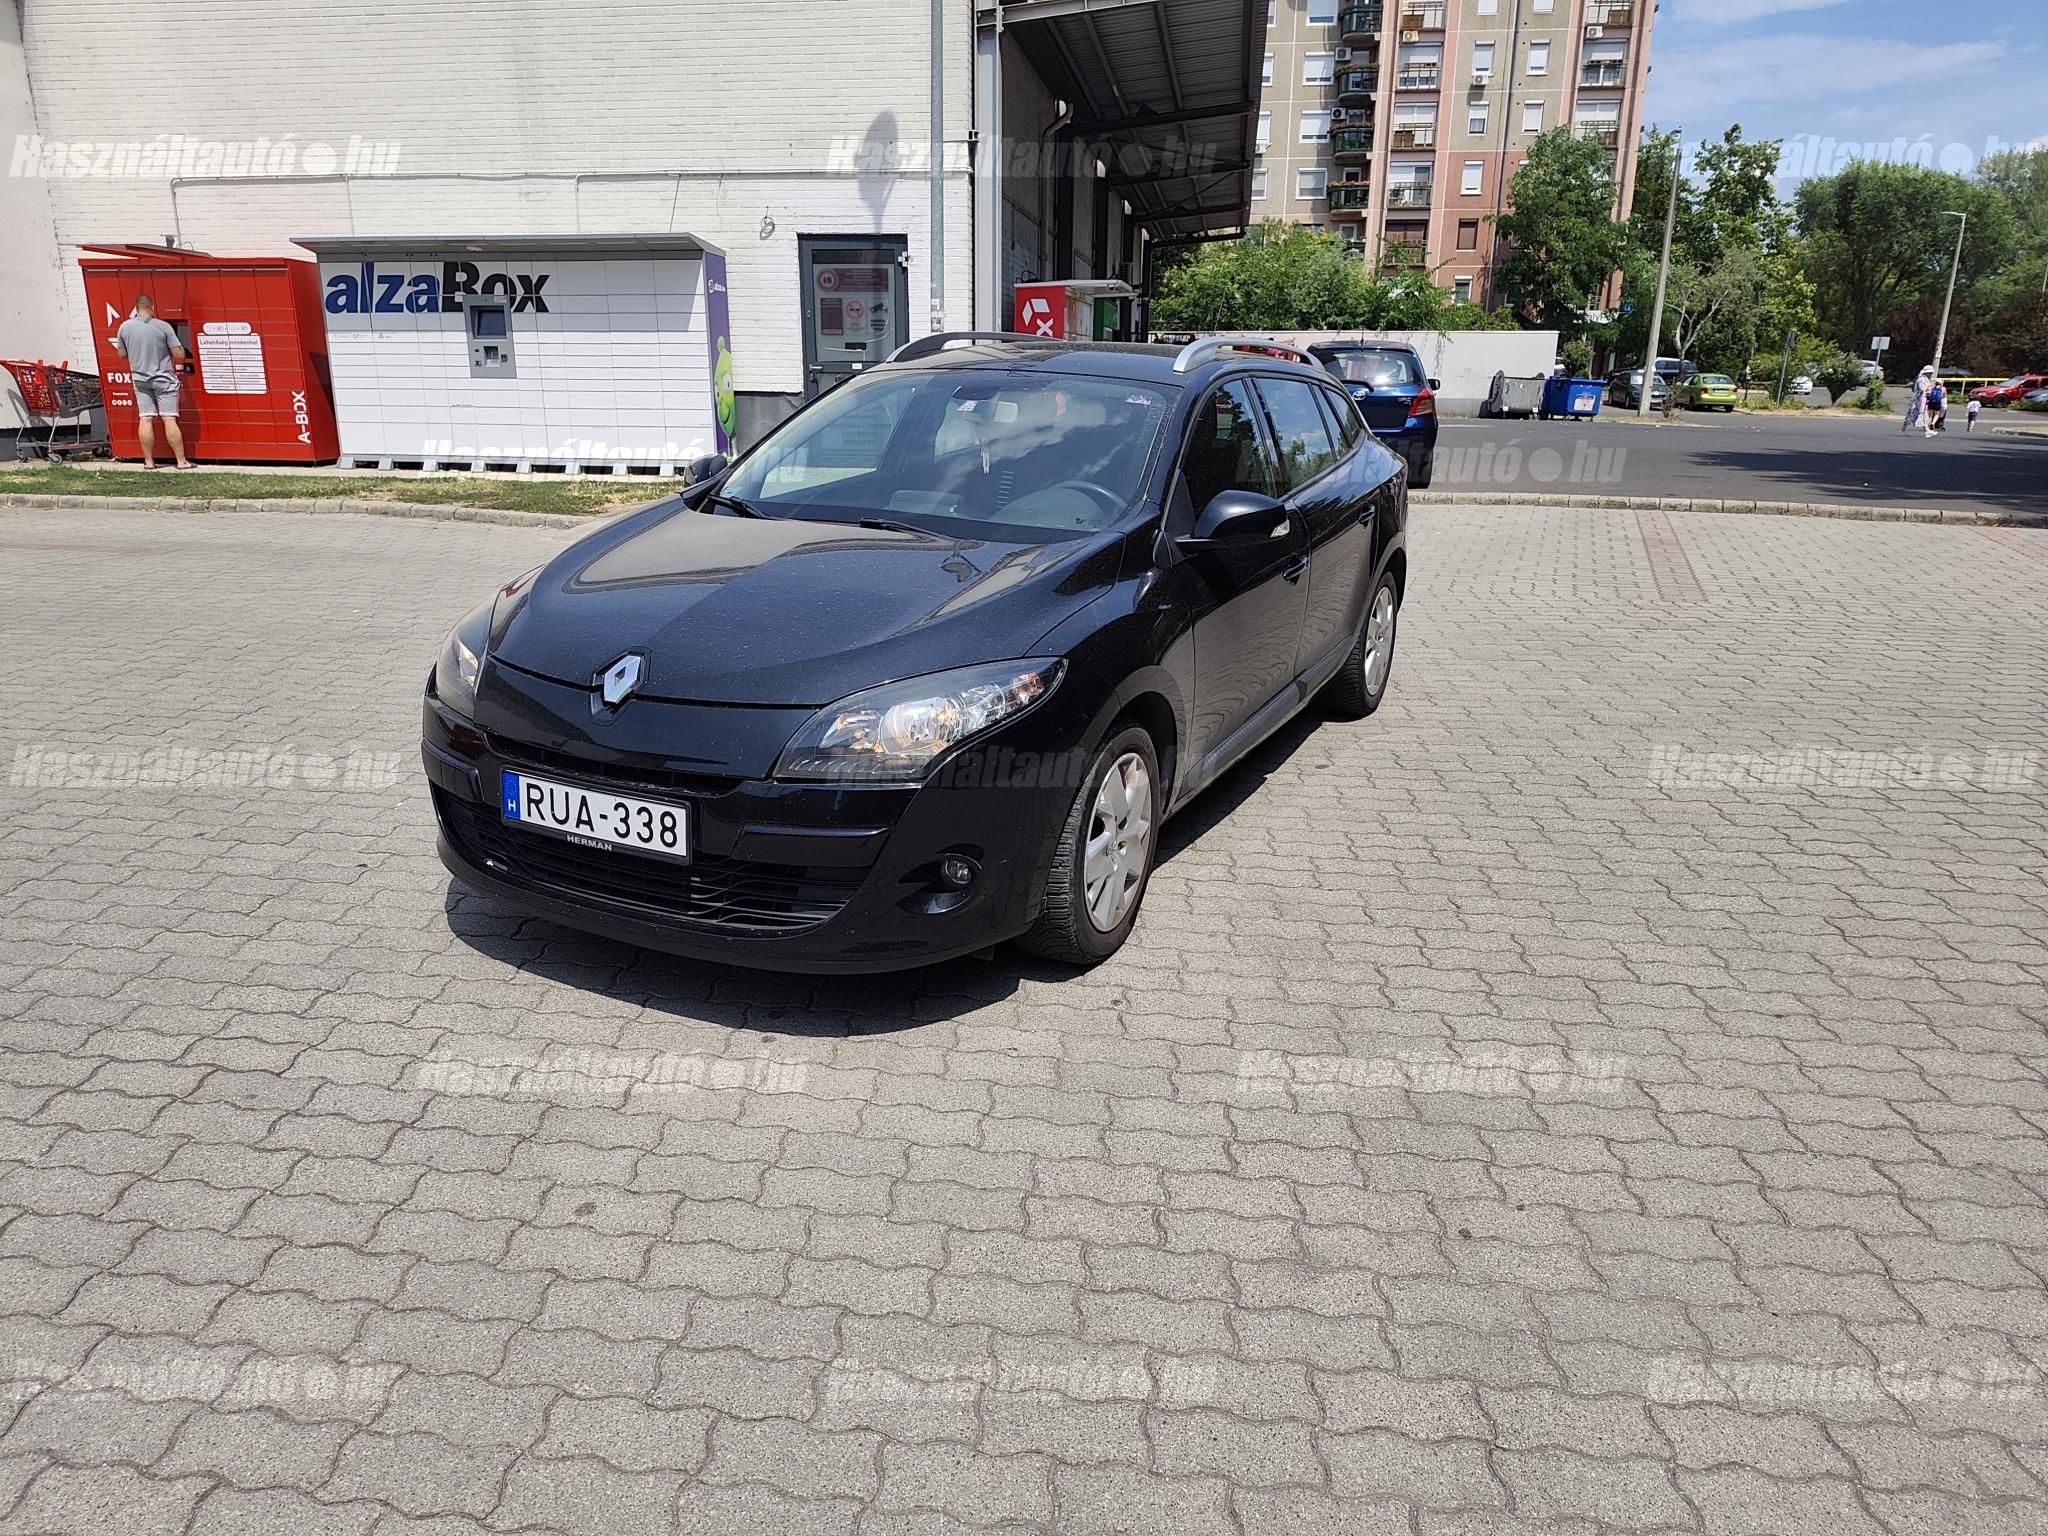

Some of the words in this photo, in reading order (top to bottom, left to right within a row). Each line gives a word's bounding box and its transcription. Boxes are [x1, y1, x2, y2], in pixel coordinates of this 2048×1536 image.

[325, 261, 551, 314] alzaBox
[291, 390, 311, 444] A-BOX
[507, 798, 516, 813] H
[526, 782, 678, 848] RUA-338
[566, 834, 613, 852] HERMAN
